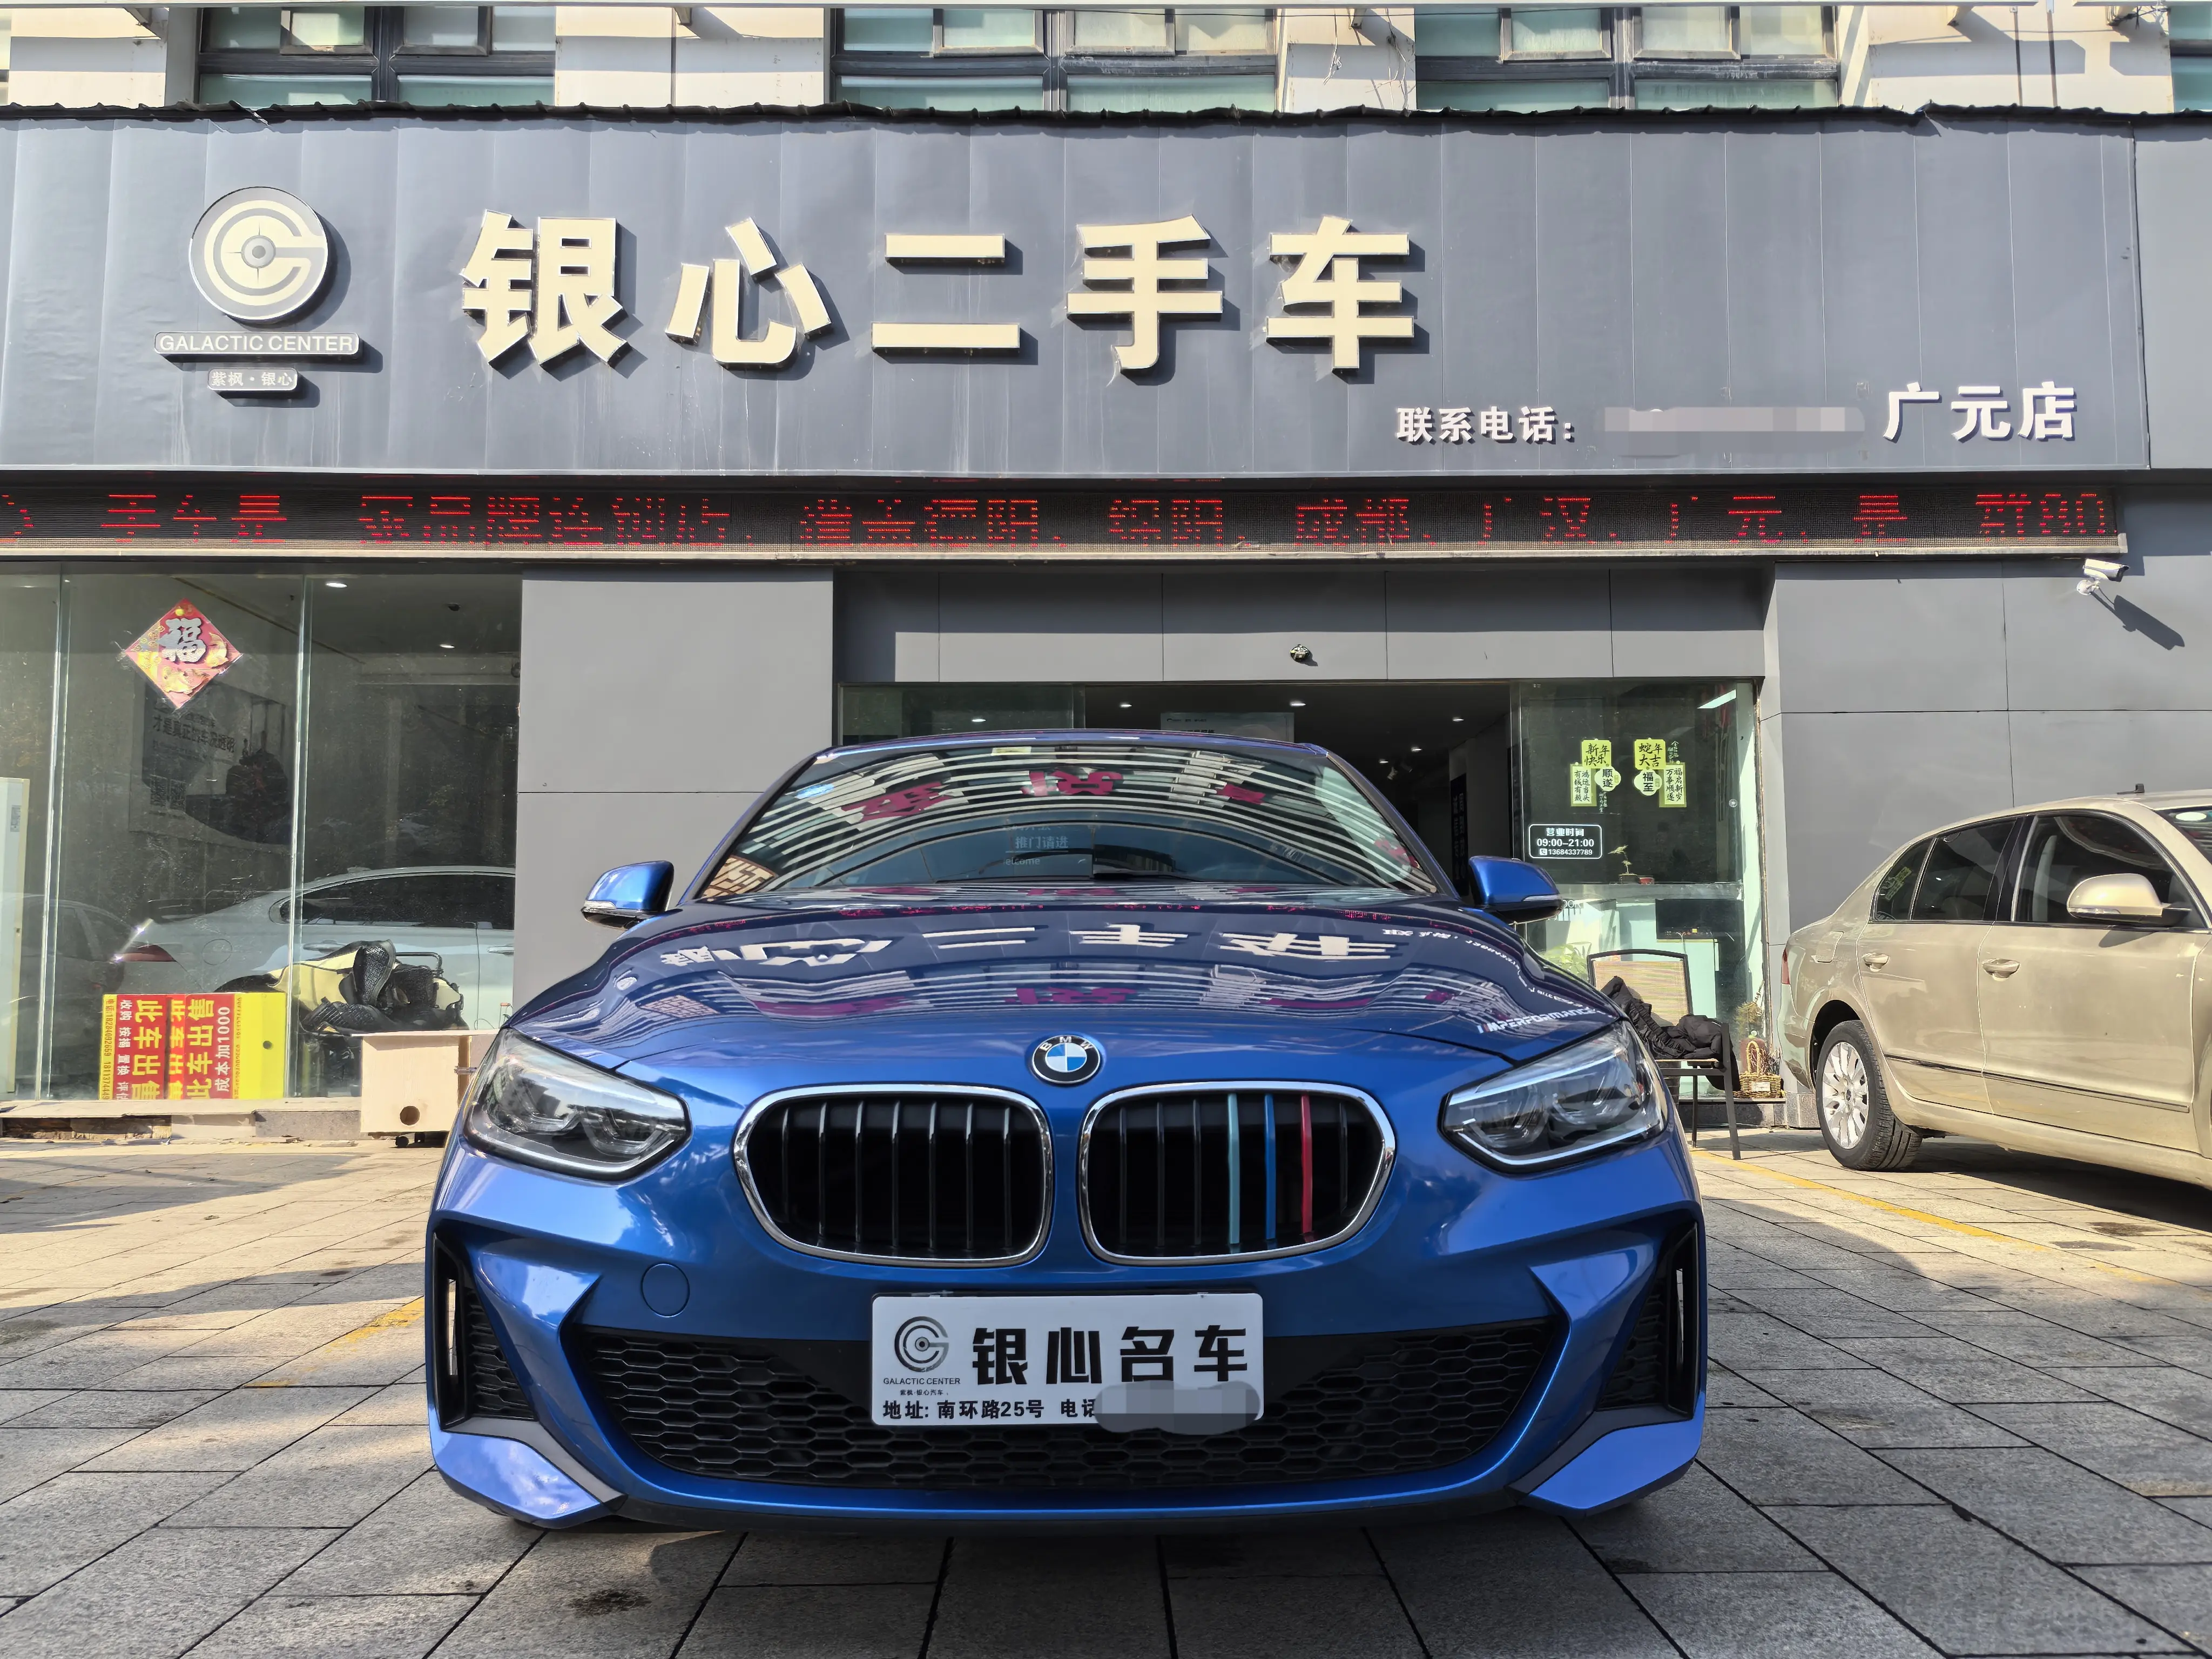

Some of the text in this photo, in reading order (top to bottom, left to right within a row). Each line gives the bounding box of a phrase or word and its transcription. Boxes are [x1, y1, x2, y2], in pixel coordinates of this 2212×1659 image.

[462, 209, 1414, 371] 银心二手车
[159, 334, 353, 351] GALACTIC CENTER
[1884, 381, 2075, 440] 广元店
[158, 617, 206, 663] 福
[1586, 743, 1610, 757] 新年
[1638, 743, 1663, 755] 蛇年
[1584, 754, 1607, 766] 快乐
[1639, 754, 1661, 767] 大吉
[1602, 768, 1614, 788] 顺遂
[1642, 772, 1654, 792] 福至
[1015, 835, 1069, 849] 推门请进
[1546, 827, 1584, 837] 营业时间
[1536, 838, 1595, 847] 09:00-21:00
[1003, 857, 1040, 866] elcome
[119, 999, 133, 1021] 收购
[118, 1027, 131, 1048] 按揭
[1039, 1036, 1094, 1052] BMW
[132, 999, 163, 1099] 此车出售
[187, 998, 214, 1099] 此车出售
[214, 1006, 231, 1092] 成本加1000
[117, 1054, 130, 1076] 置换
[972, 1325, 1247, 1385] 银心名车
[937, 1399, 1045, 1419] 南环路25号
